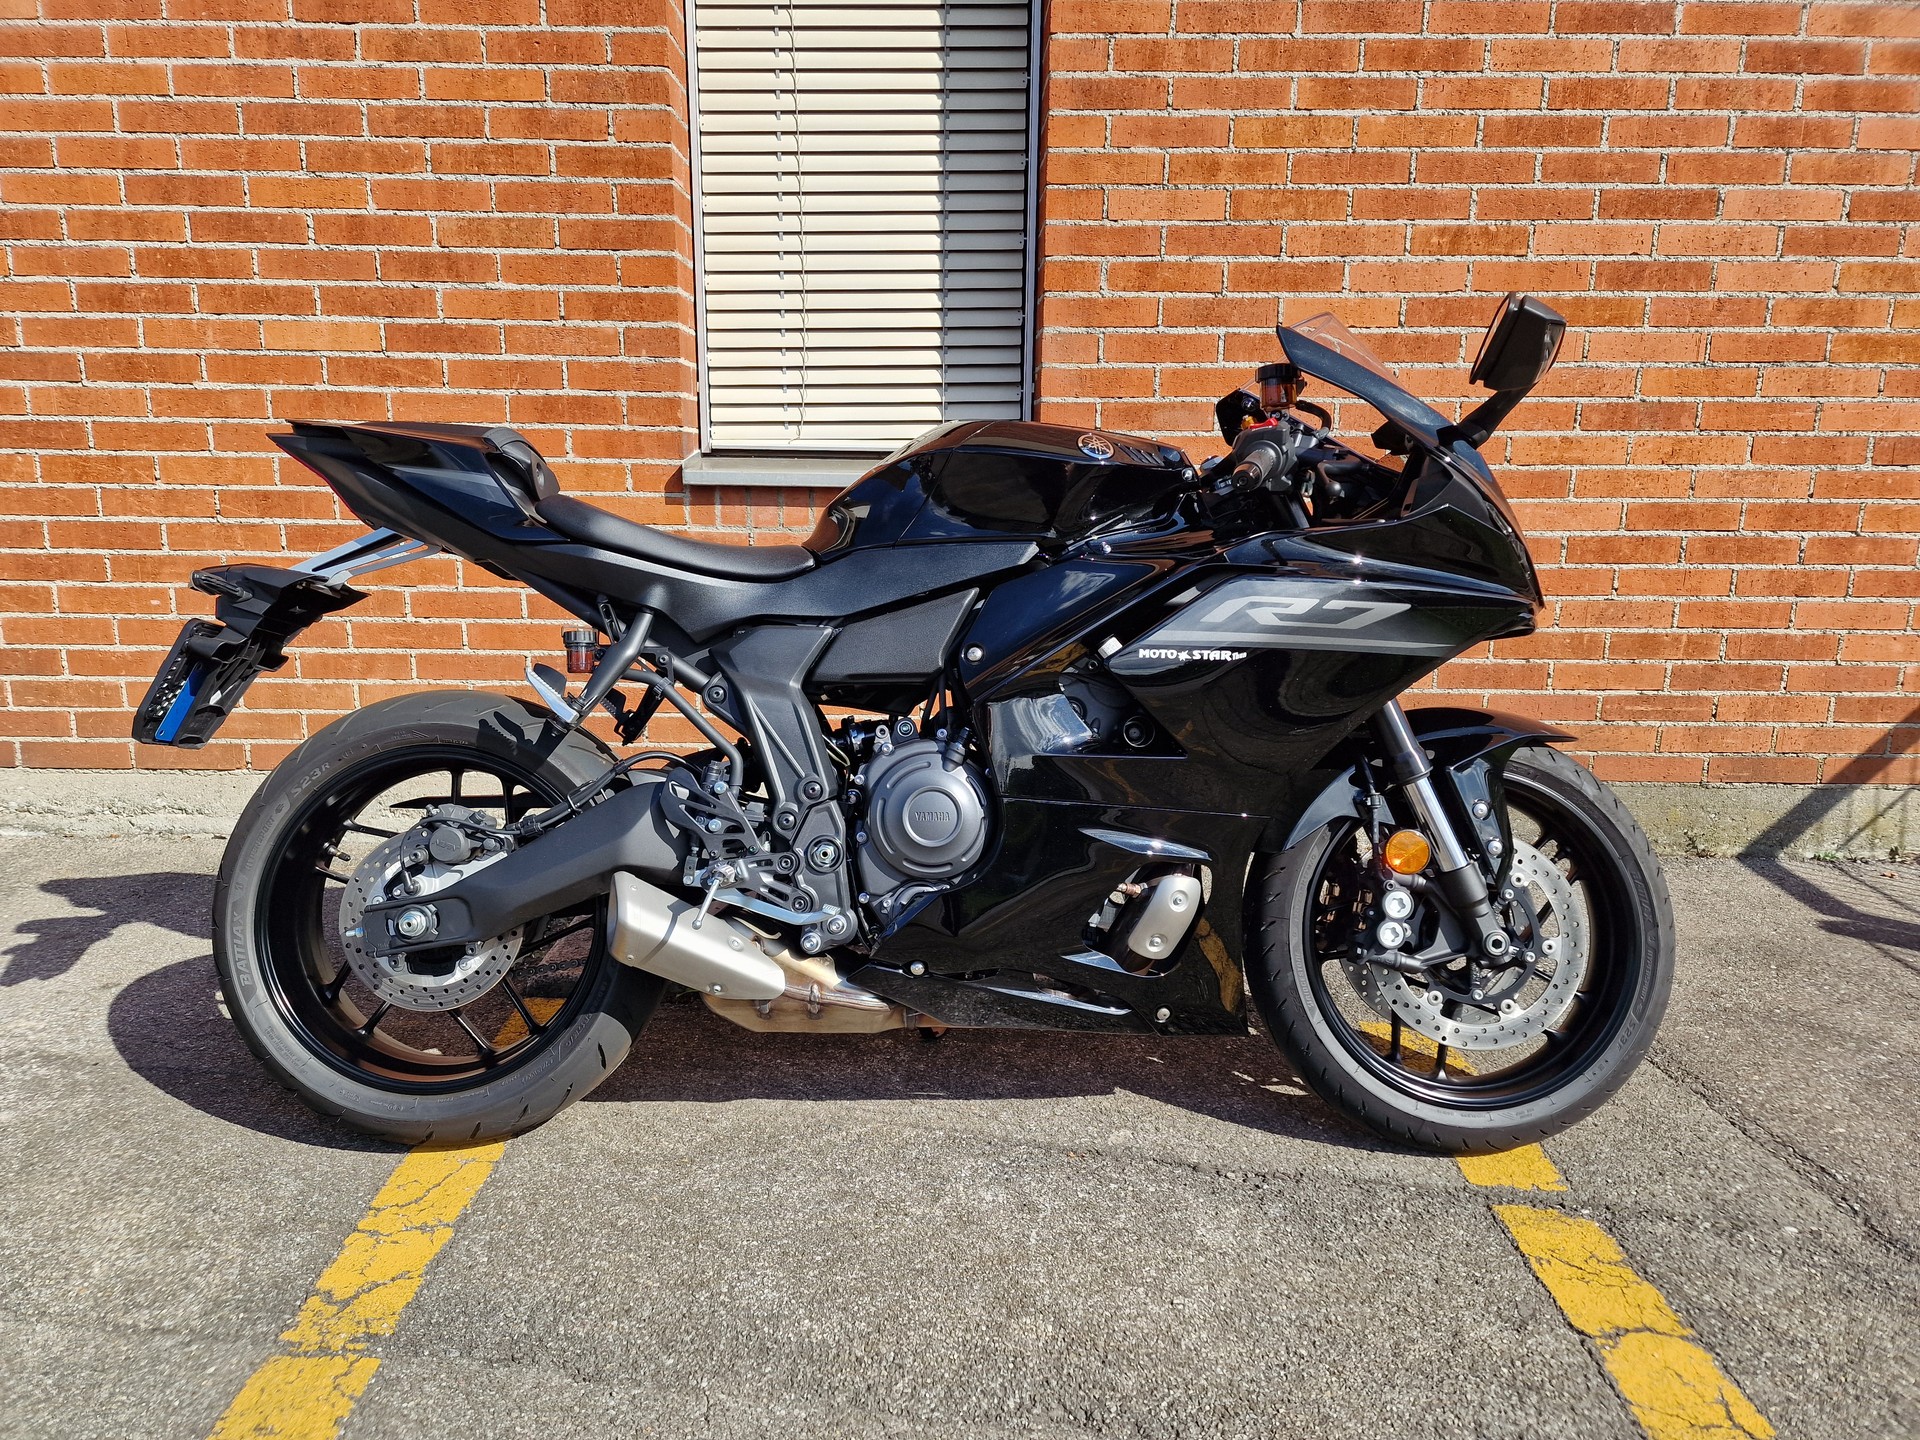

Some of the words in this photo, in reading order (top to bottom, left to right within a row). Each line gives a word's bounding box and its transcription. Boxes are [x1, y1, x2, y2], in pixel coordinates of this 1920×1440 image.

[1200, 595, 1412, 629] R7
[1138, 648, 1178, 660] MOTO
[1192, 649, 1232, 661] STAR
[914, 811, 950, 821] YAMAHA
[232, 911, 253, 987] BATTLAX
[290, 761, 331, 797] S23R
[1295, 951, 1313, 1008] BRIDGESTONE
